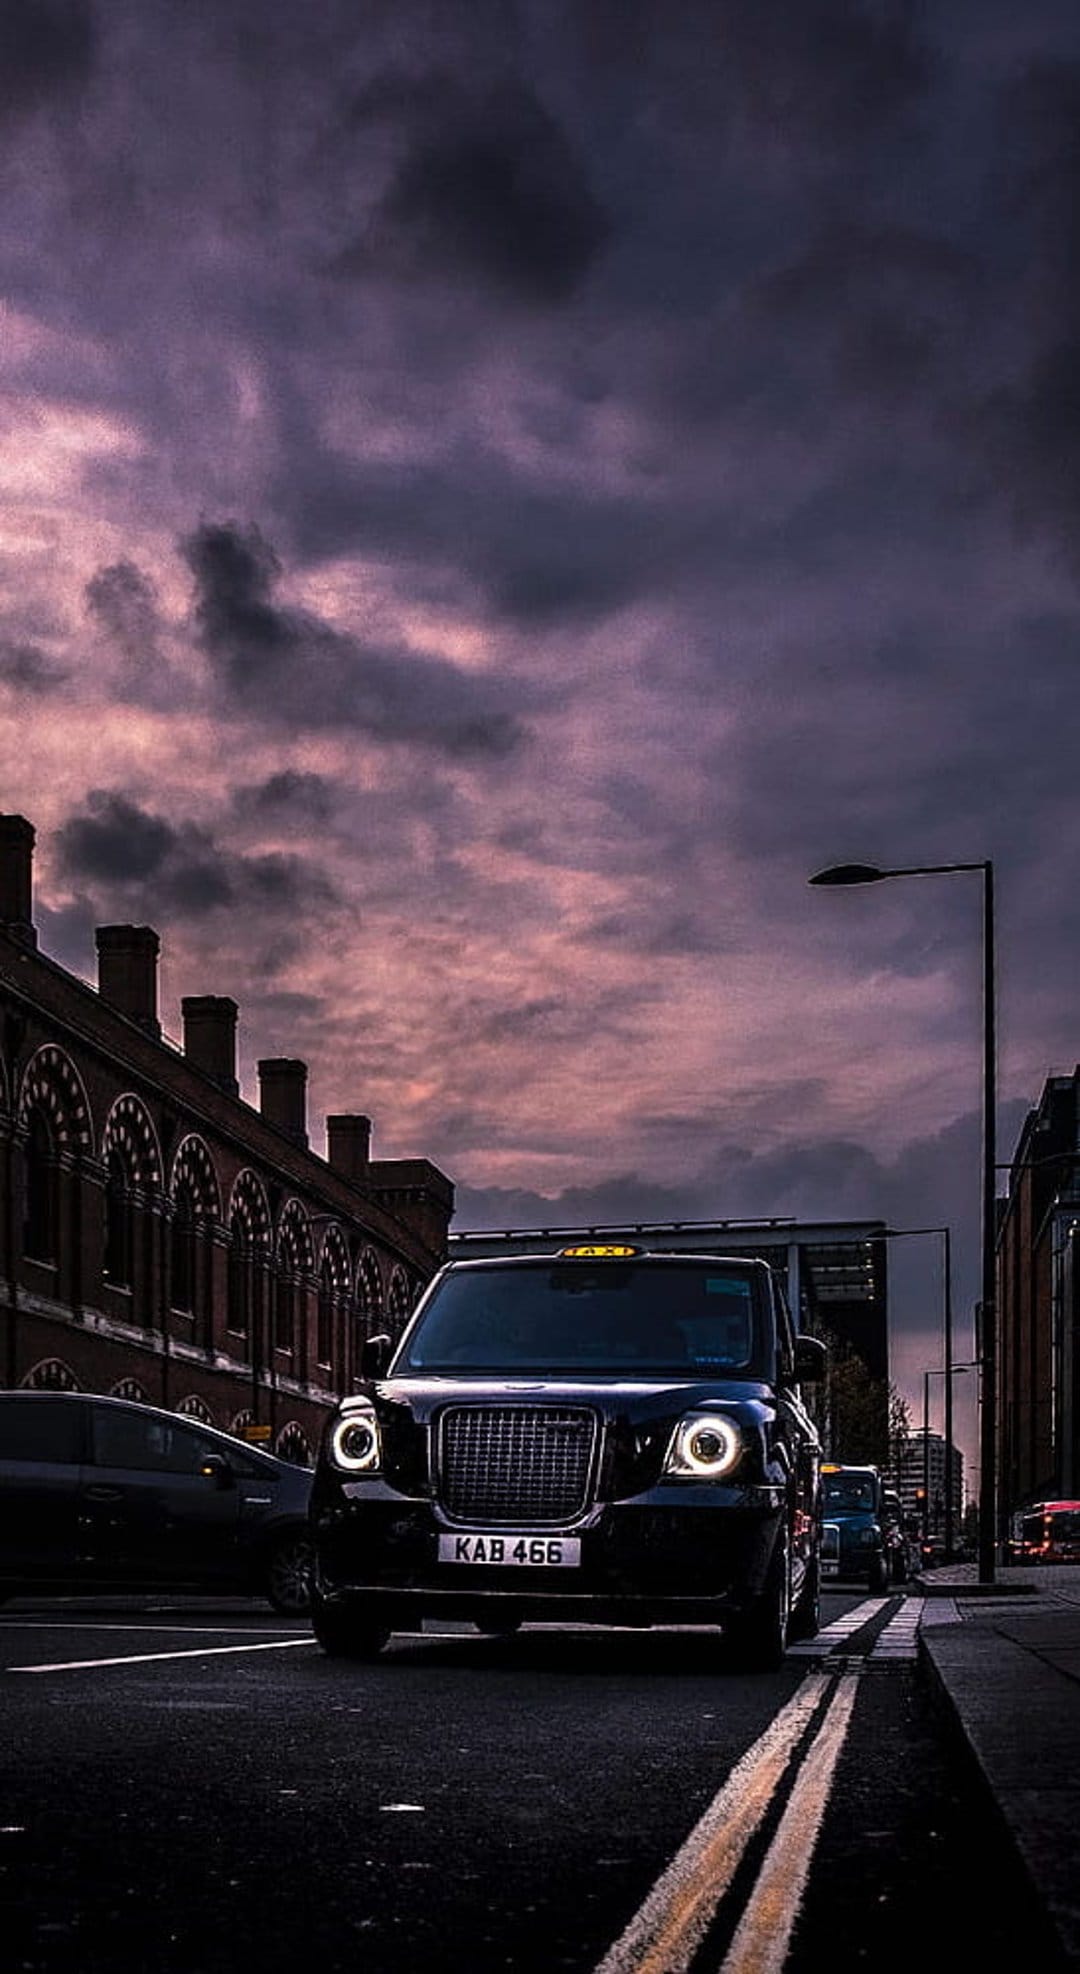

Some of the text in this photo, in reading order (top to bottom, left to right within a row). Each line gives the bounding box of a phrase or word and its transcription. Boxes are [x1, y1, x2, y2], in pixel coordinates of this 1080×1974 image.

[568, 1246, 629, 1257] TAXI
[455, 1537, 563, 1564] KAB 466
